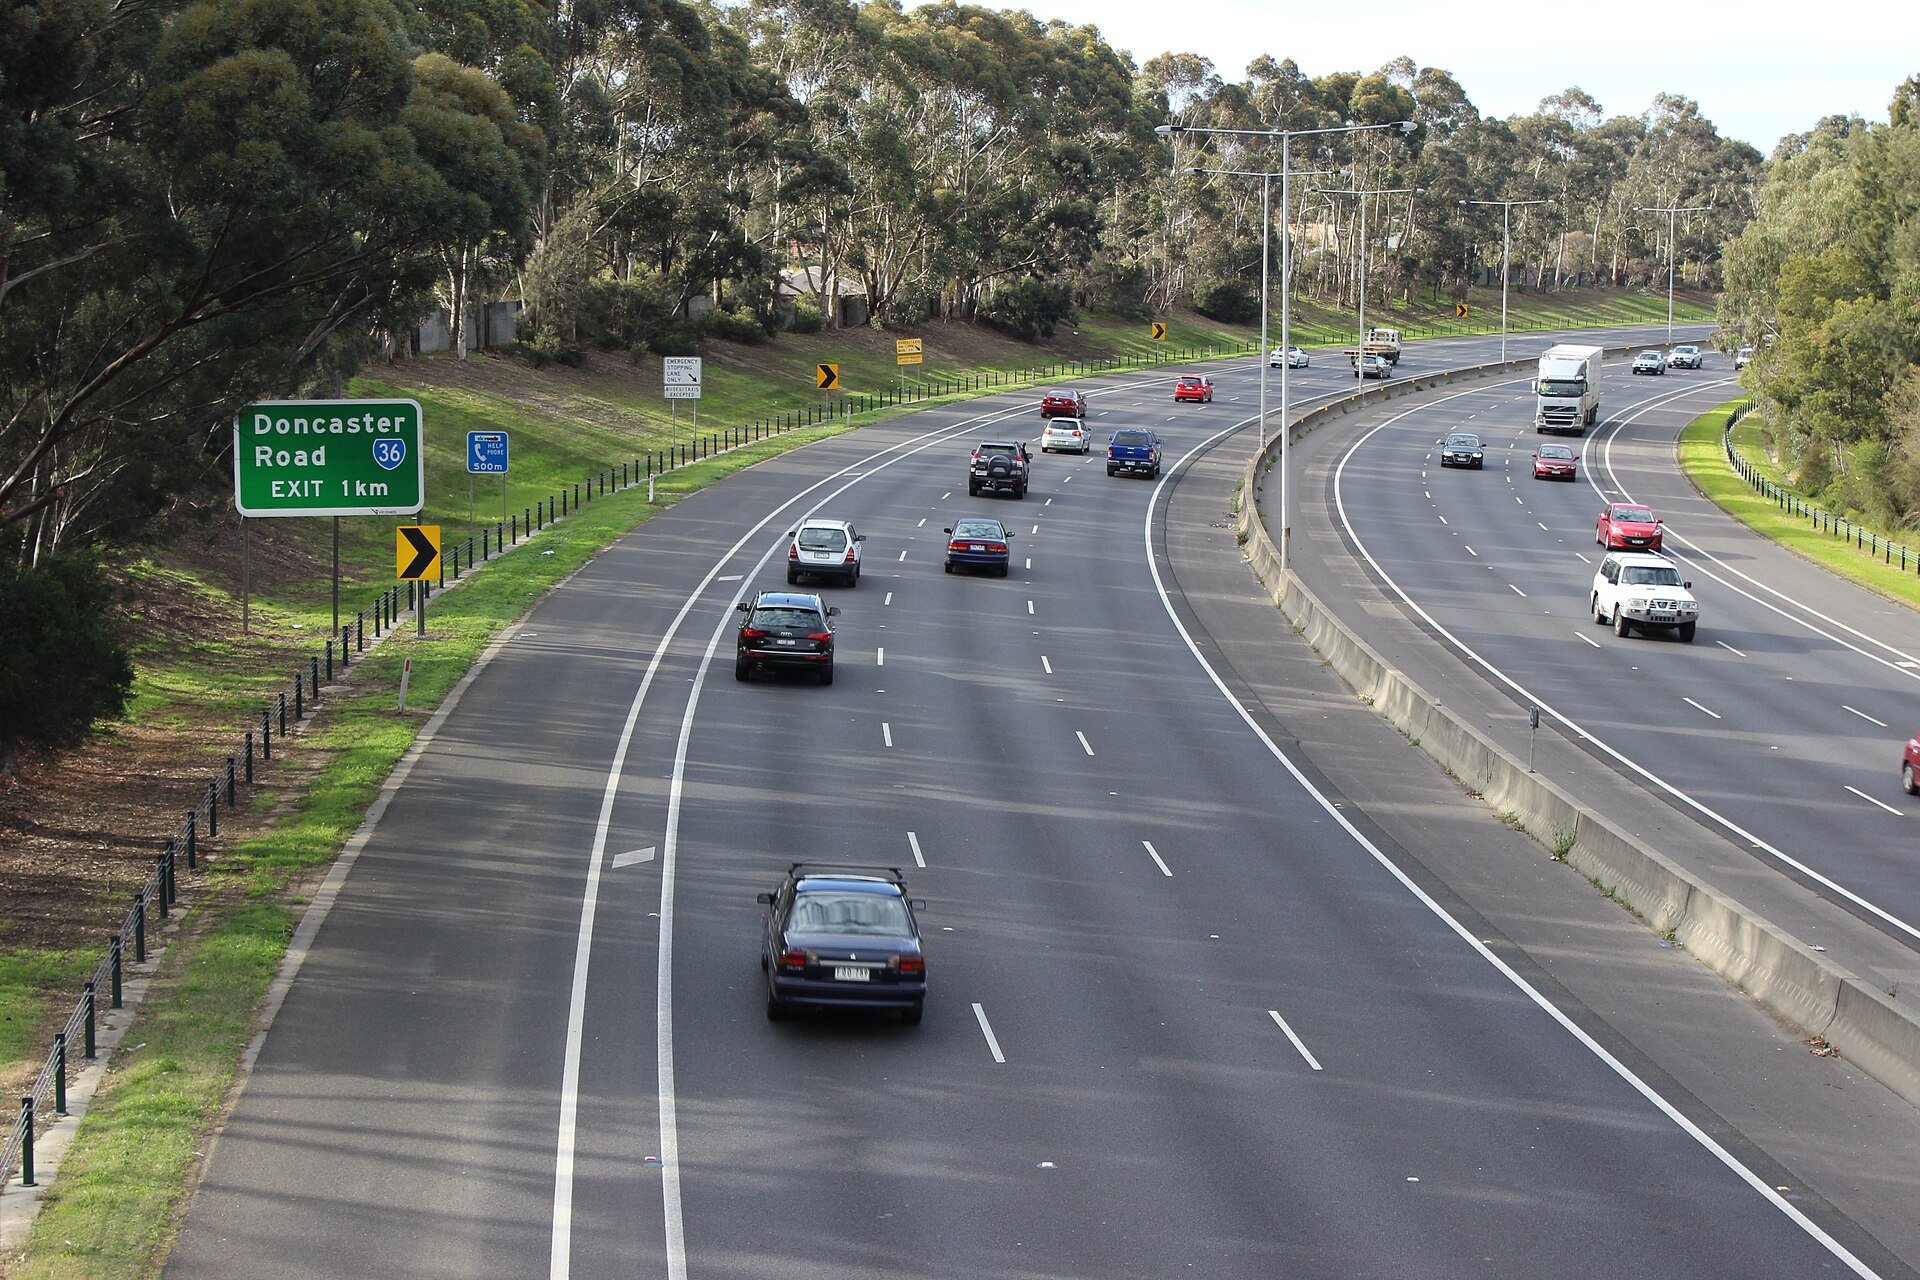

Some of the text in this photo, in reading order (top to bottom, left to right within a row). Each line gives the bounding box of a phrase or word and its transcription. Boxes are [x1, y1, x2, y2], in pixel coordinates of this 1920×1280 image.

[254, 413, 405, 435] Doncaster
[255, 445, 326, 467] Road
[378, 443, 400, 462] 36
[271, 480, 324, 498] EXIT
